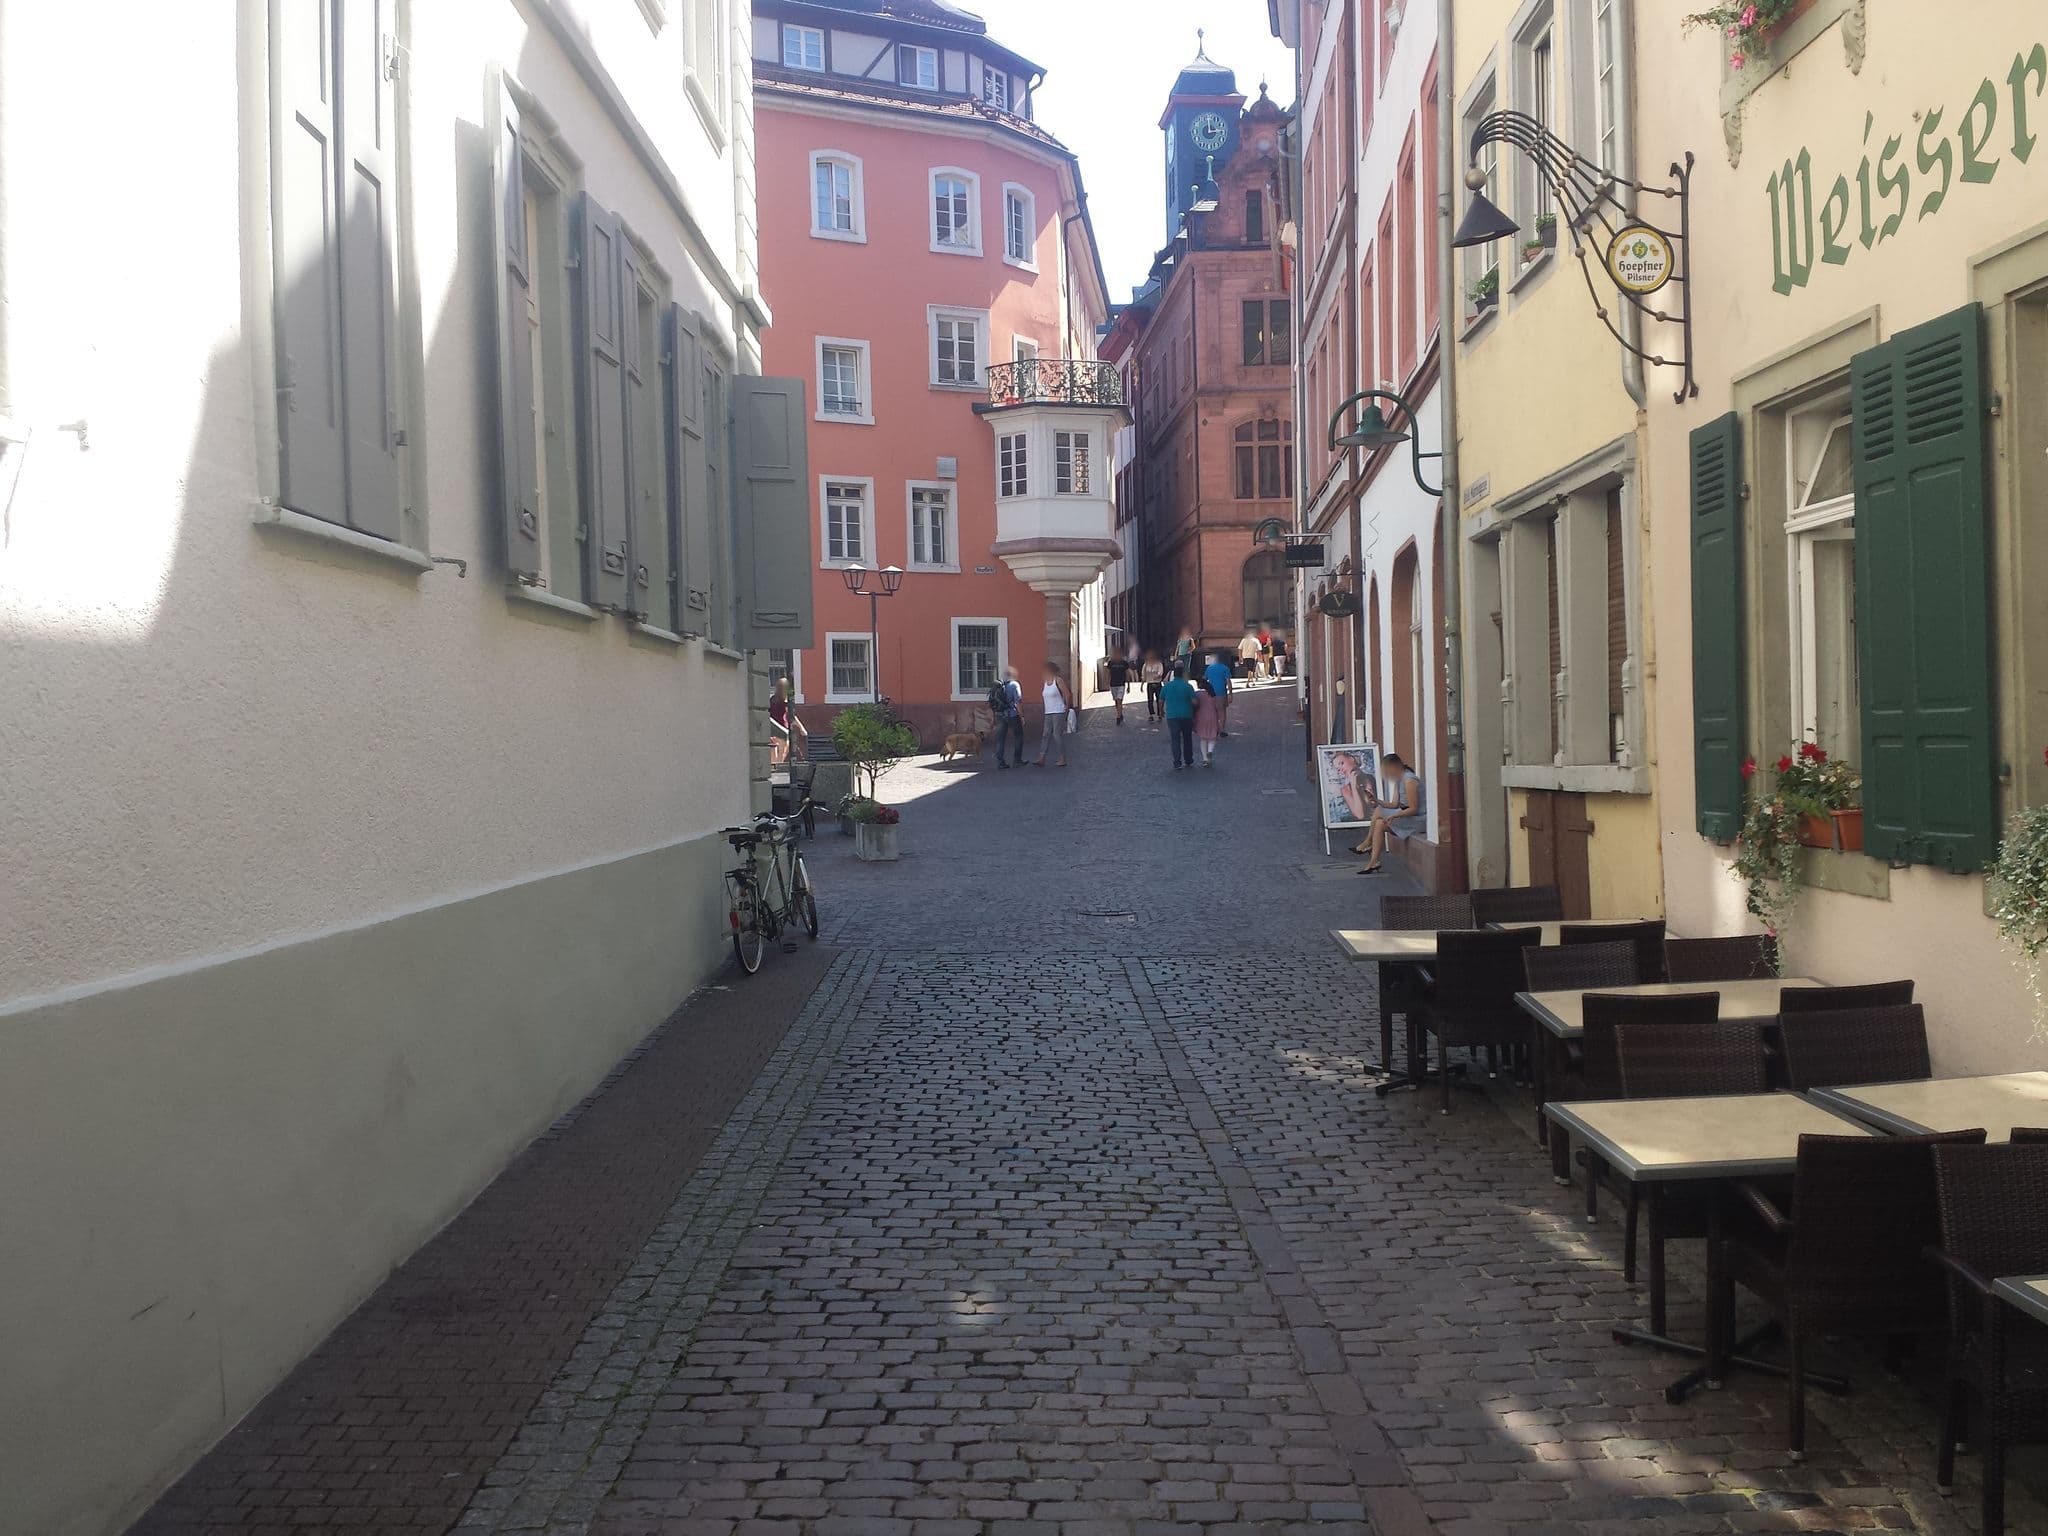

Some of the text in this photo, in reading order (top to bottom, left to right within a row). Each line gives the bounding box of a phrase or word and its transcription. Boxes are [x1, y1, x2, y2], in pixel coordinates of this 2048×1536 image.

[1766, 43, 2047, 297] Weisser
[1618, 261, 1664, 272] Hoepfner
[1627, 273, 1656, 282] Pilsner
[1333, 594, 1345, 607] V
